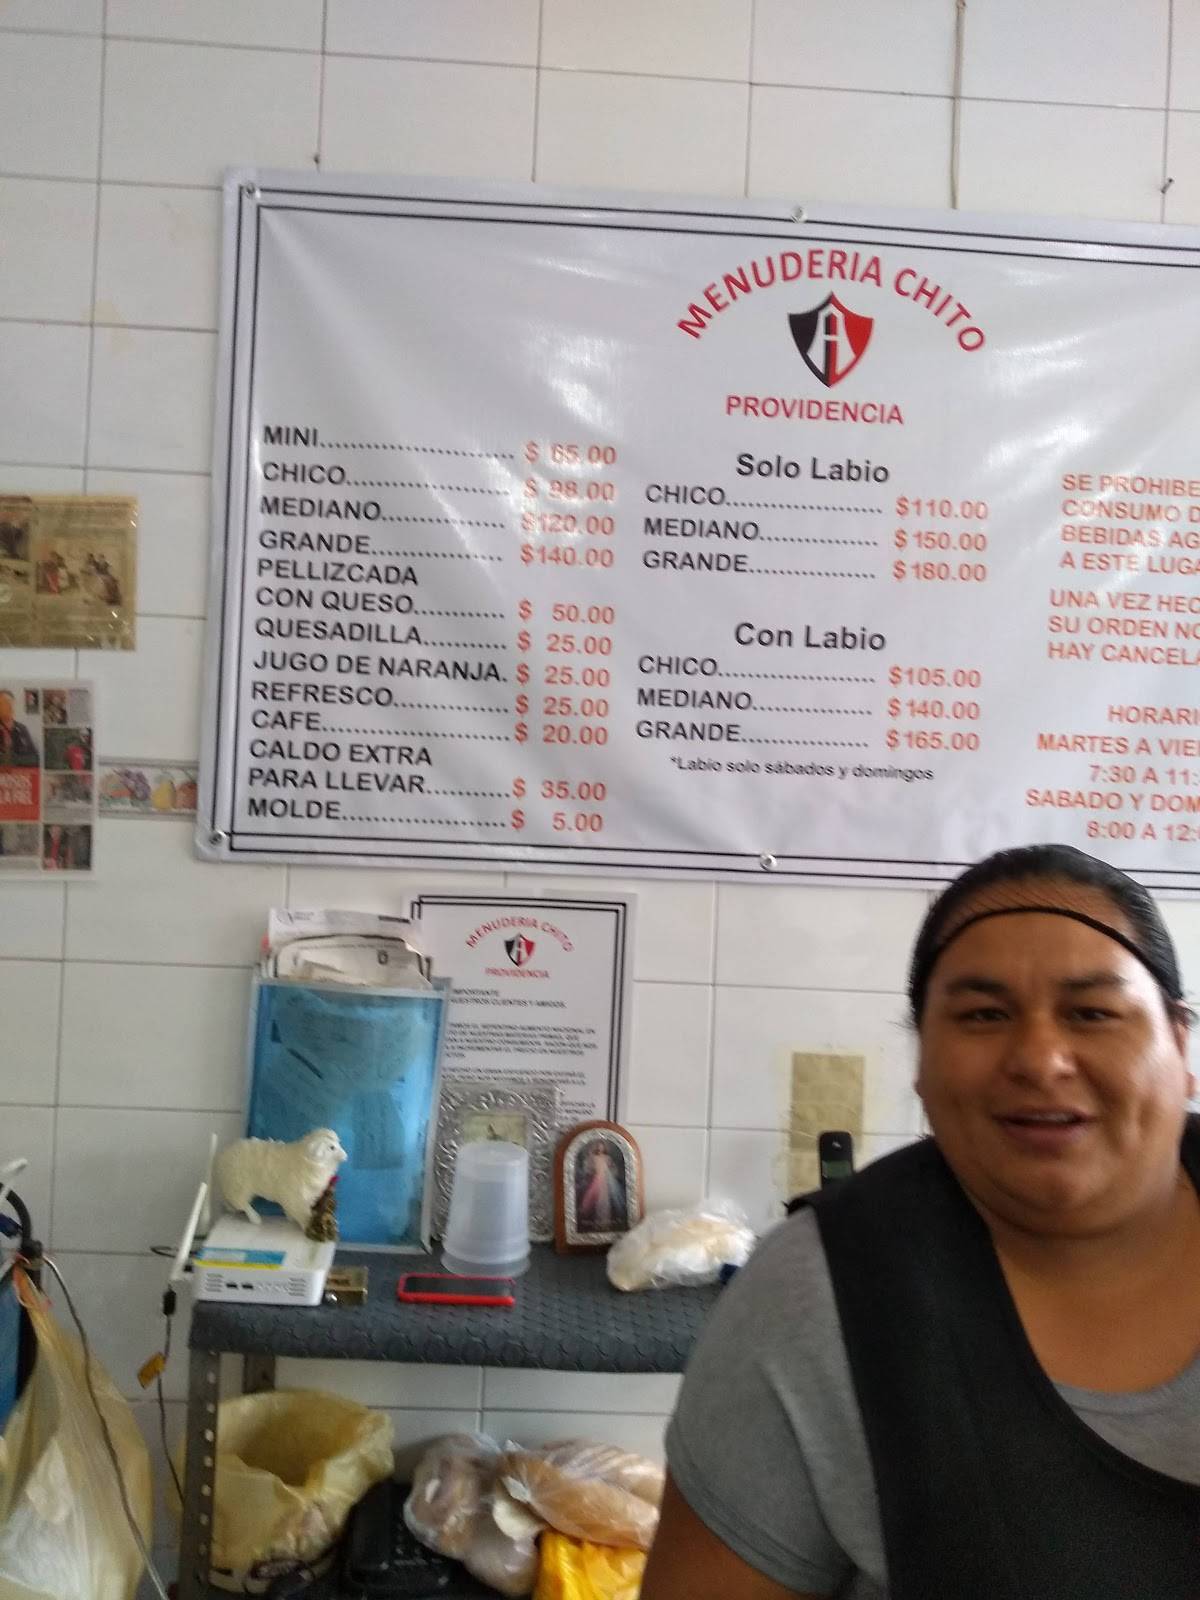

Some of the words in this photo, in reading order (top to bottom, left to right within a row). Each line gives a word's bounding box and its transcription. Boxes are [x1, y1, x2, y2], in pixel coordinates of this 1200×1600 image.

[677, 248, 882, 339] MENUDERIA
[894, 268, 985, 352] CHITO
[726, 395, 904, 425] PROVIDENCIA
[736, 453, 801, 479] Solo
[812, 457, 890, 483] Labio
[1062, 474, 1093, 491] SE
[1100, 475, 1200, 498] PROHIBE
[896, 496, 988, 520] $110.00
[1062, 499, 1181, 522] CONSUMO
[1061, 525, 1162, 548] BEBIDAS
[520, 543, 614, 569] $140.00
[1060, 551, 1076, 569] A
[1082, 553, 1139, 573] ESTE
[257, 559, 419, 586] PELLIZCADA
[256, 587, 314, 609] CON
[552, 604, 615, 625] 50.00
[1050, 589, 1099, 609] UNA
[1106, 592, 1152, 612] VEZ
[735, 622, 793, 648] Con
[805, 625, 886, 651] Labio
[1049, 615, 1080, 634] SU
[1087, 617, 1168, 639] ORDEN
[547, 633, 613, 656] 25.00
[1047, 640, 1095, 660] HAY
[1102, 644, 1200, 666] CANCEL
[254, 650, 328, 673] JUGO
[336, 655, 370, 675] DE
[544, 666, 611, 688] 25.00
[889, 666, 981, 689] $105.00
[543, 696, 610, 719] 25.00
[543, 724, 609, 746] 20.00
[886, 729, 980, 752] $165.00
[1037, 732, 1129, 754] MARTES
[1136, 737, 1151, 755] A
[1158, 738, 1200, 758] VIE
[250, 739, 340, 762] CALDO
[350, 743, 433, 767] EXTRA
[726, 760, 760, 774] solo
[838, 766, 848, 780] y
[852, 764, 934, 782] domingos
[1089, 763, 1136, 784] 7:30
[1142, 766, 1158, 785] A
[248, 768, 319, 790] PARA
[541, 780, 606, 802] 35.00
[1026, 788, 1123, 811] SABADO
[1129, 793, 1143, 812] Y
[552, 813, 603, 833] 5.00
[1087, 820, 1135, 840] 8:00
[1141, 822, 1157, 841] A
[1163, 824, 1200, 842] 12:
